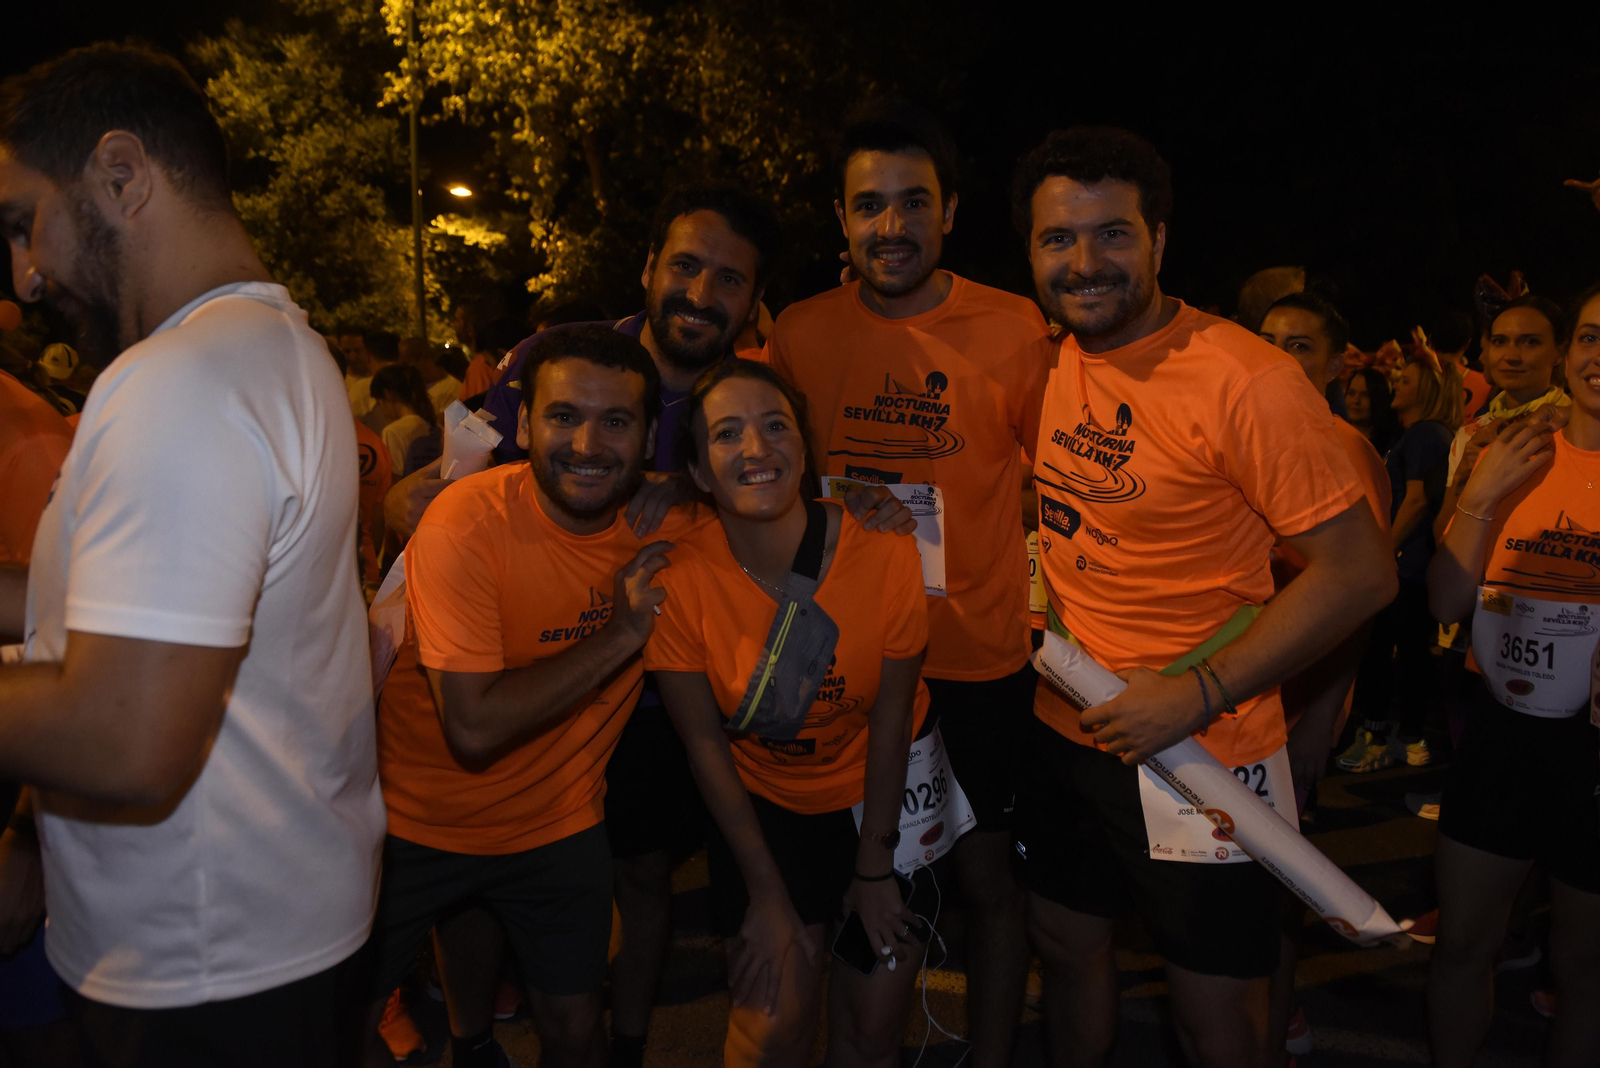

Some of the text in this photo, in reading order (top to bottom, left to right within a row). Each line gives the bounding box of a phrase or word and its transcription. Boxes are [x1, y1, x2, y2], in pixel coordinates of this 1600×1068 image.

[843, 406, 906, 425] SEVILLA
[874, 395, 950, 415] NOCTURNA
[1051, 429, 1094, 461] SEVILLA
[1504, 538, 1572, 560] SEVILLA
[1500, 632, 1555, 670] 3651
[1532, 671, 1555, 681] TOLEDO
[1177, 807, 1195, 816] JOSÉ
[1261, 857, 1325, 913] nederlanden
